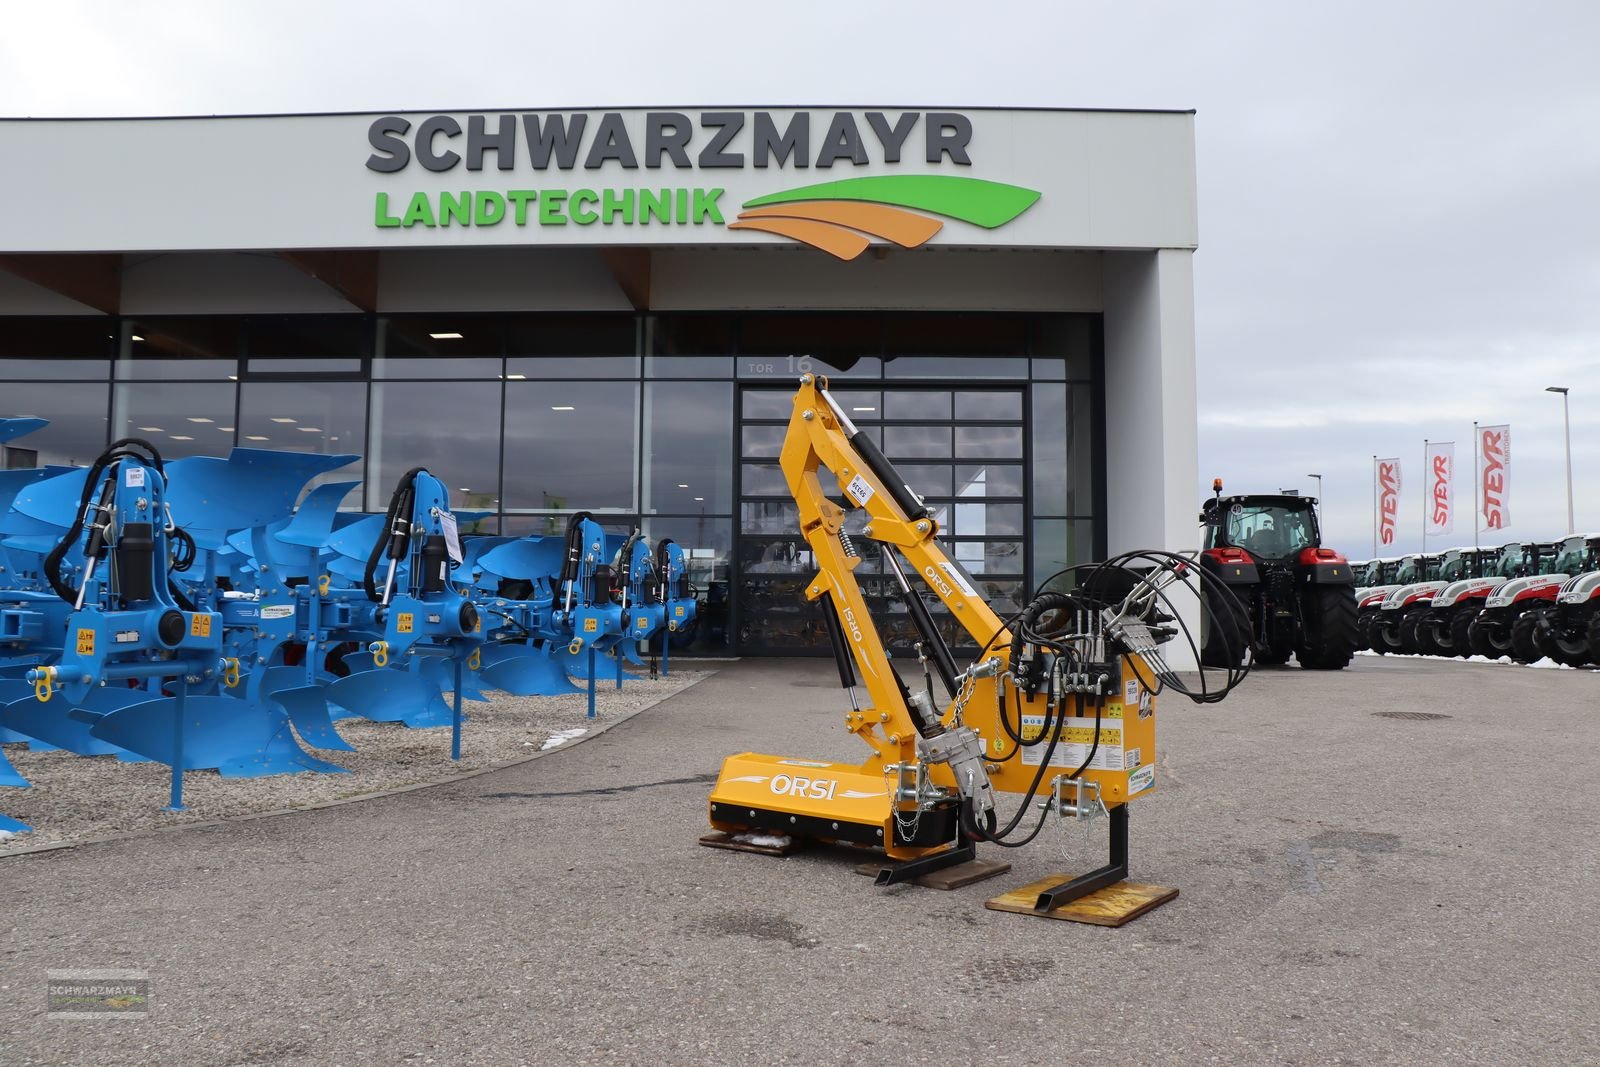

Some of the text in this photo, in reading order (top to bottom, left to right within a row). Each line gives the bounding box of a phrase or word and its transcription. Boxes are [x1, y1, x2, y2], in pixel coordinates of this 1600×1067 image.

[365, 111, 972, 173] SCHWARZMAYR
[375, 188, 725, 228] LANDTECHNIK
[749, 355, 812, 373] TOR 16
[1433, 455, 1449, 526] STEYR
[1483, 430, 1503, 529] STEYR
[1380, 462, 1397, 544] STEYR
[925, 566, 953, 598] ORSI
[843, 607, 862, 642] ORSI
[770, 773, 838, 800] ORSI
